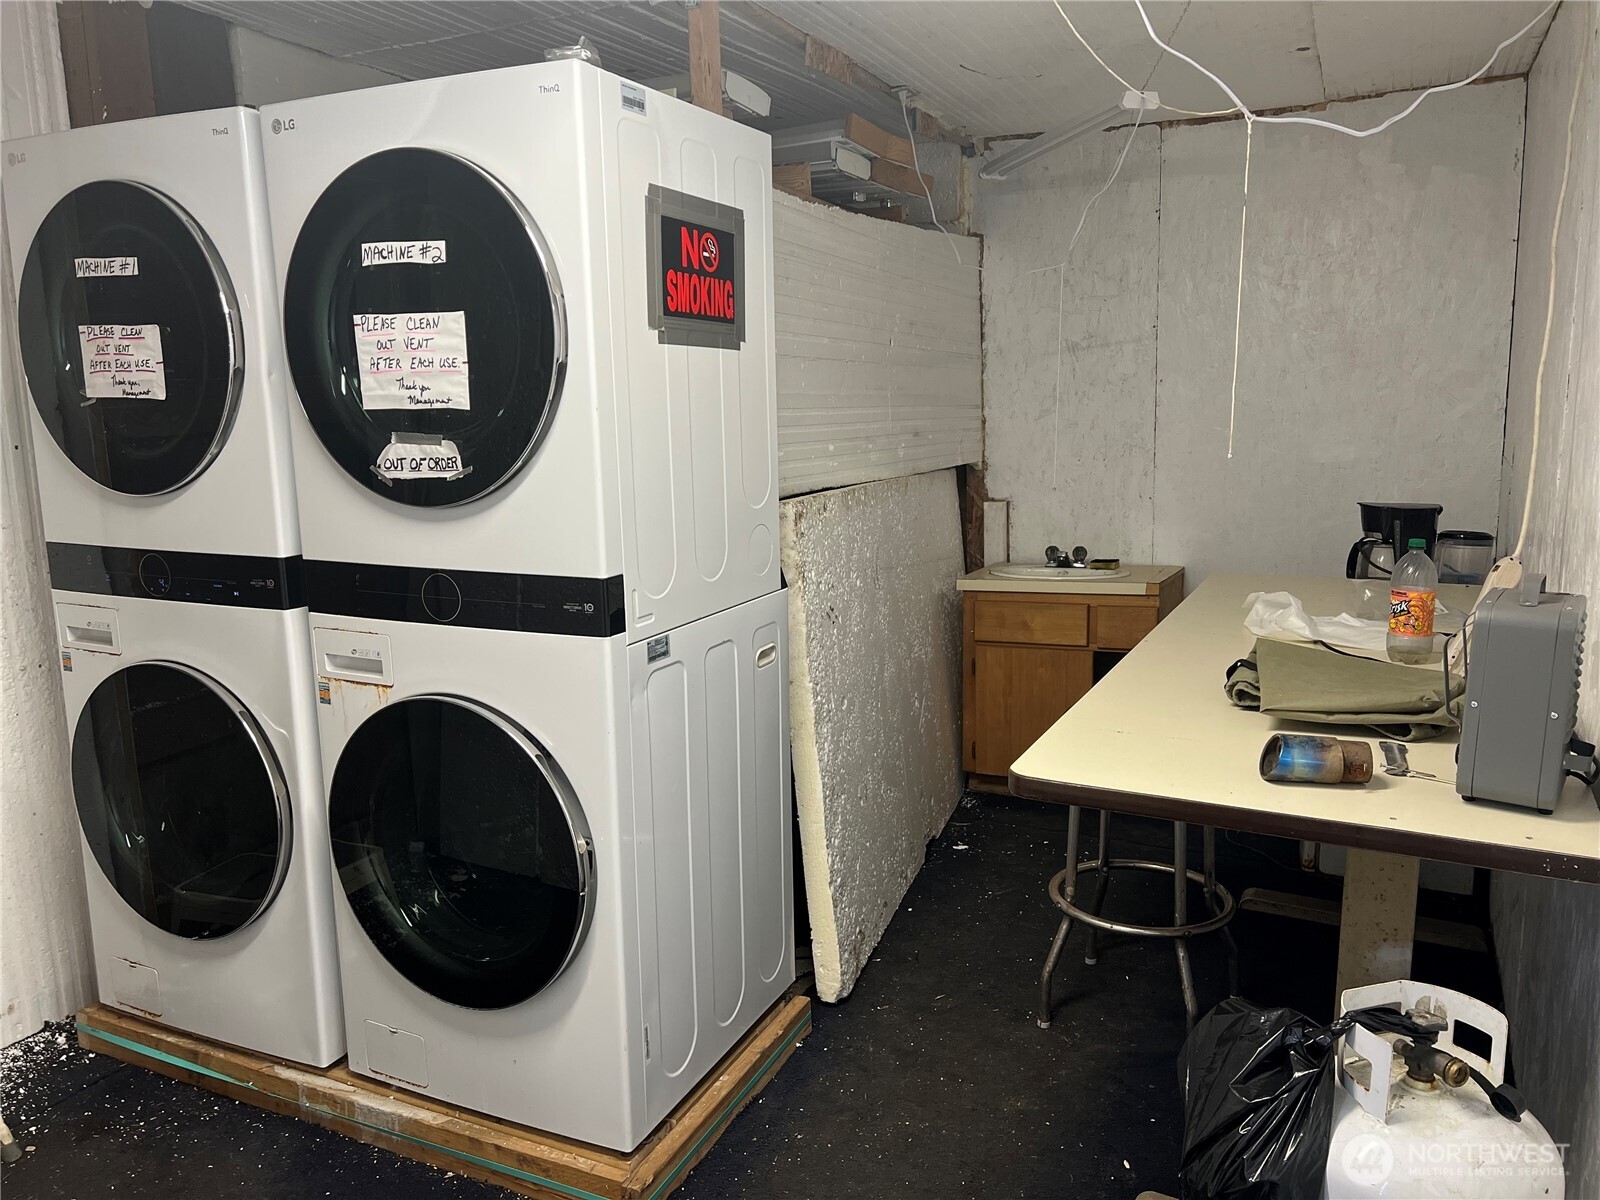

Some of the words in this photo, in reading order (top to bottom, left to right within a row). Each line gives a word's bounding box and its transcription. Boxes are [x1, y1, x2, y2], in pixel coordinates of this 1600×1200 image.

[538, 84, 560, 94] ThinQ
[283, 118, 295, 131] LG
[211, 127, 229, 136] ThinQ
[16, 153, 26, 164] LG
[362, 245, 416, 264] MACHINE
[419, 242, 445, 263] #2
[681, 226, 720, 273] NO
[76, 260, 116, 275] MACHINE
[119, 258, 136, 276] #1
[666, 269, 734, 319] SMOKING
[360, 315, 397, 333] PLEASE
[406, 316, 440, 330] CLEAN
[86, 325, 115, 337] PLEASE
[120, 327, 143, 338] CLEAN
[96, 344, 110, 353] OUT
[113, 344, 131, 353] VENT
[376, 339, 396, 351] OUT
[403, 337, 434, 350] VENT
[89, 360, 112, 371] AFTER
[115, 361, 132, 370] EACH
[369, 358, 402, 371] AFTER
[410, 360, 434, 370] EACH
[438, 360, 460, 370] USE.
[111, 374, 127, 387] Thank
[396, 377, 418, 391] Thank
[418, 384, 431, 398] you
[407, 395, 452, 407] Management
[383, 457, 406, 471] OUT
[409, 457, 425, 471] OF
[427, 456, 459, 471] ORDER
[584, 603, 594, 611] 10
